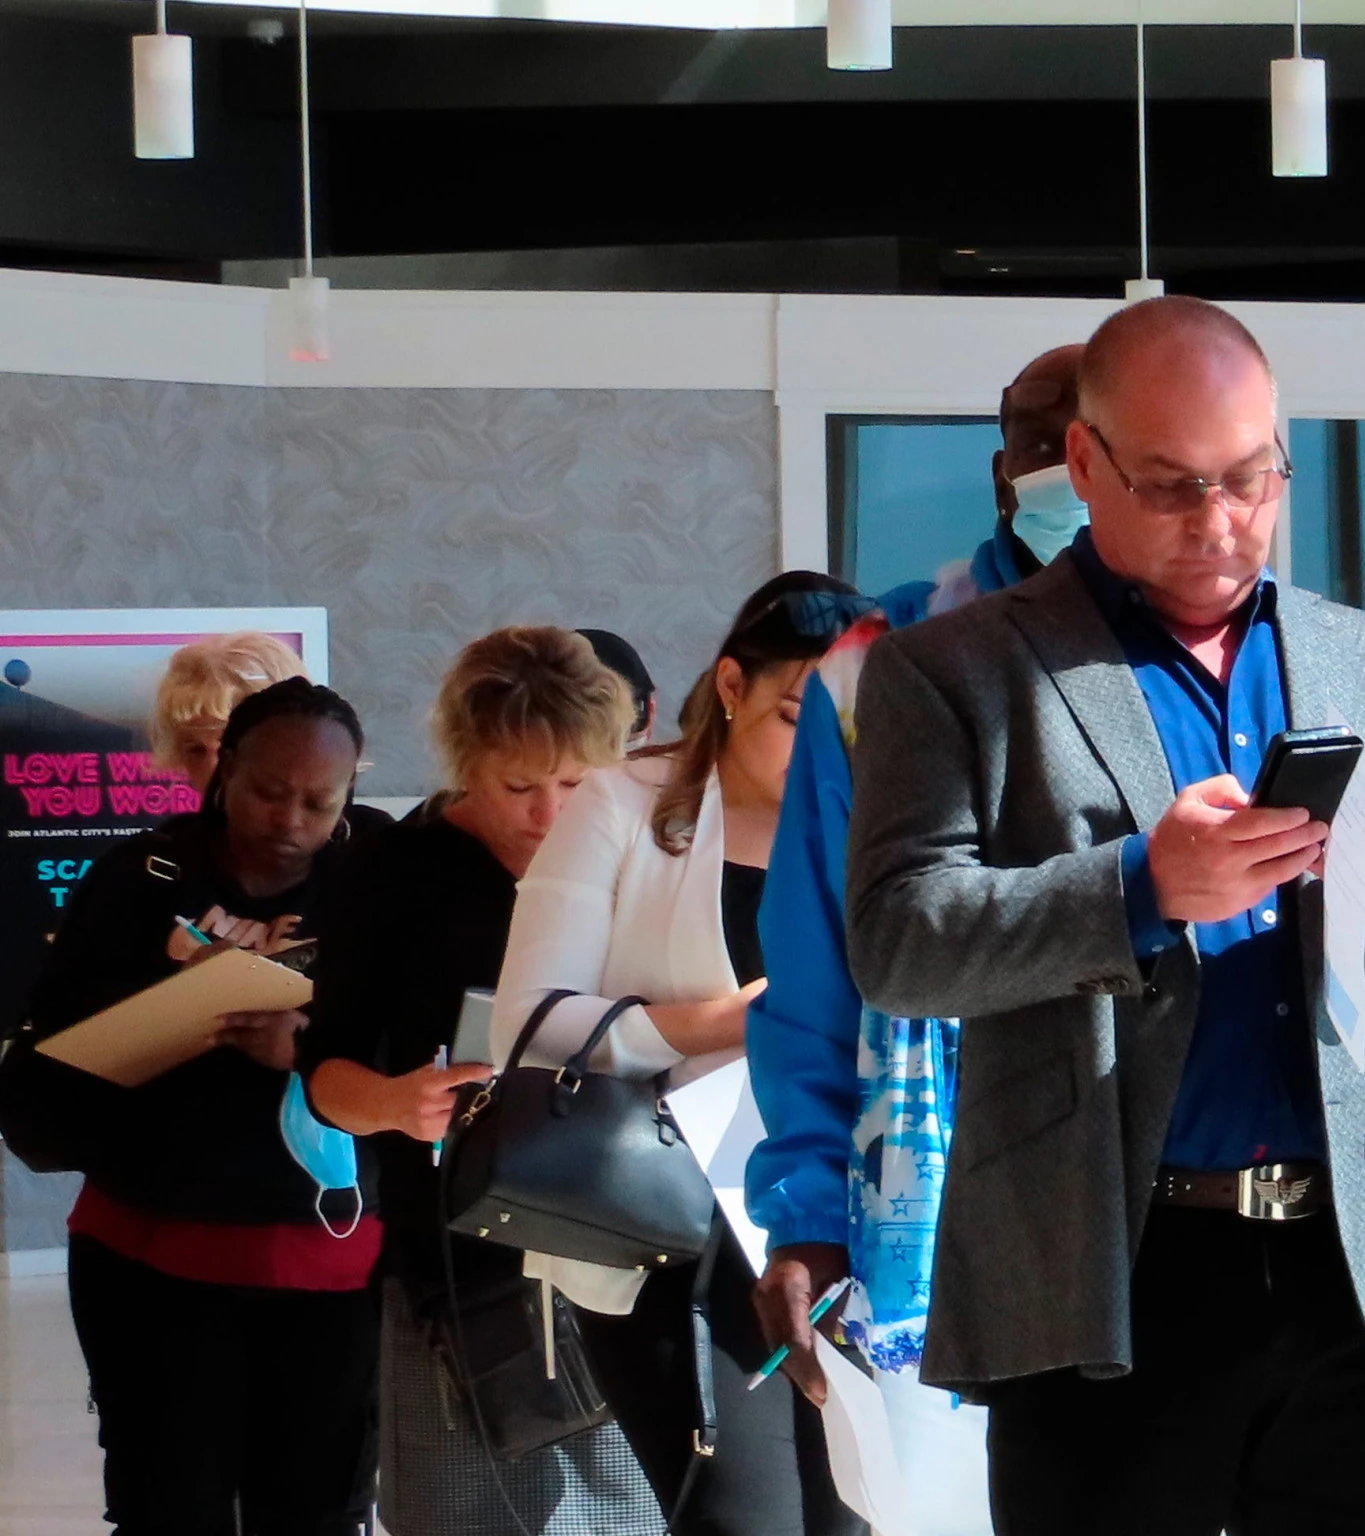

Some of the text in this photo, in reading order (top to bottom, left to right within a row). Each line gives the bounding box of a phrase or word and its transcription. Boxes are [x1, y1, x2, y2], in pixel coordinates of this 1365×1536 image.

[5, 752, 99, 784] LOVE
[21, 786, 101, 817] YOU
[33, 828, 79, 838] ATLANTIC
[81, 828, 111, 837] CITY'S
